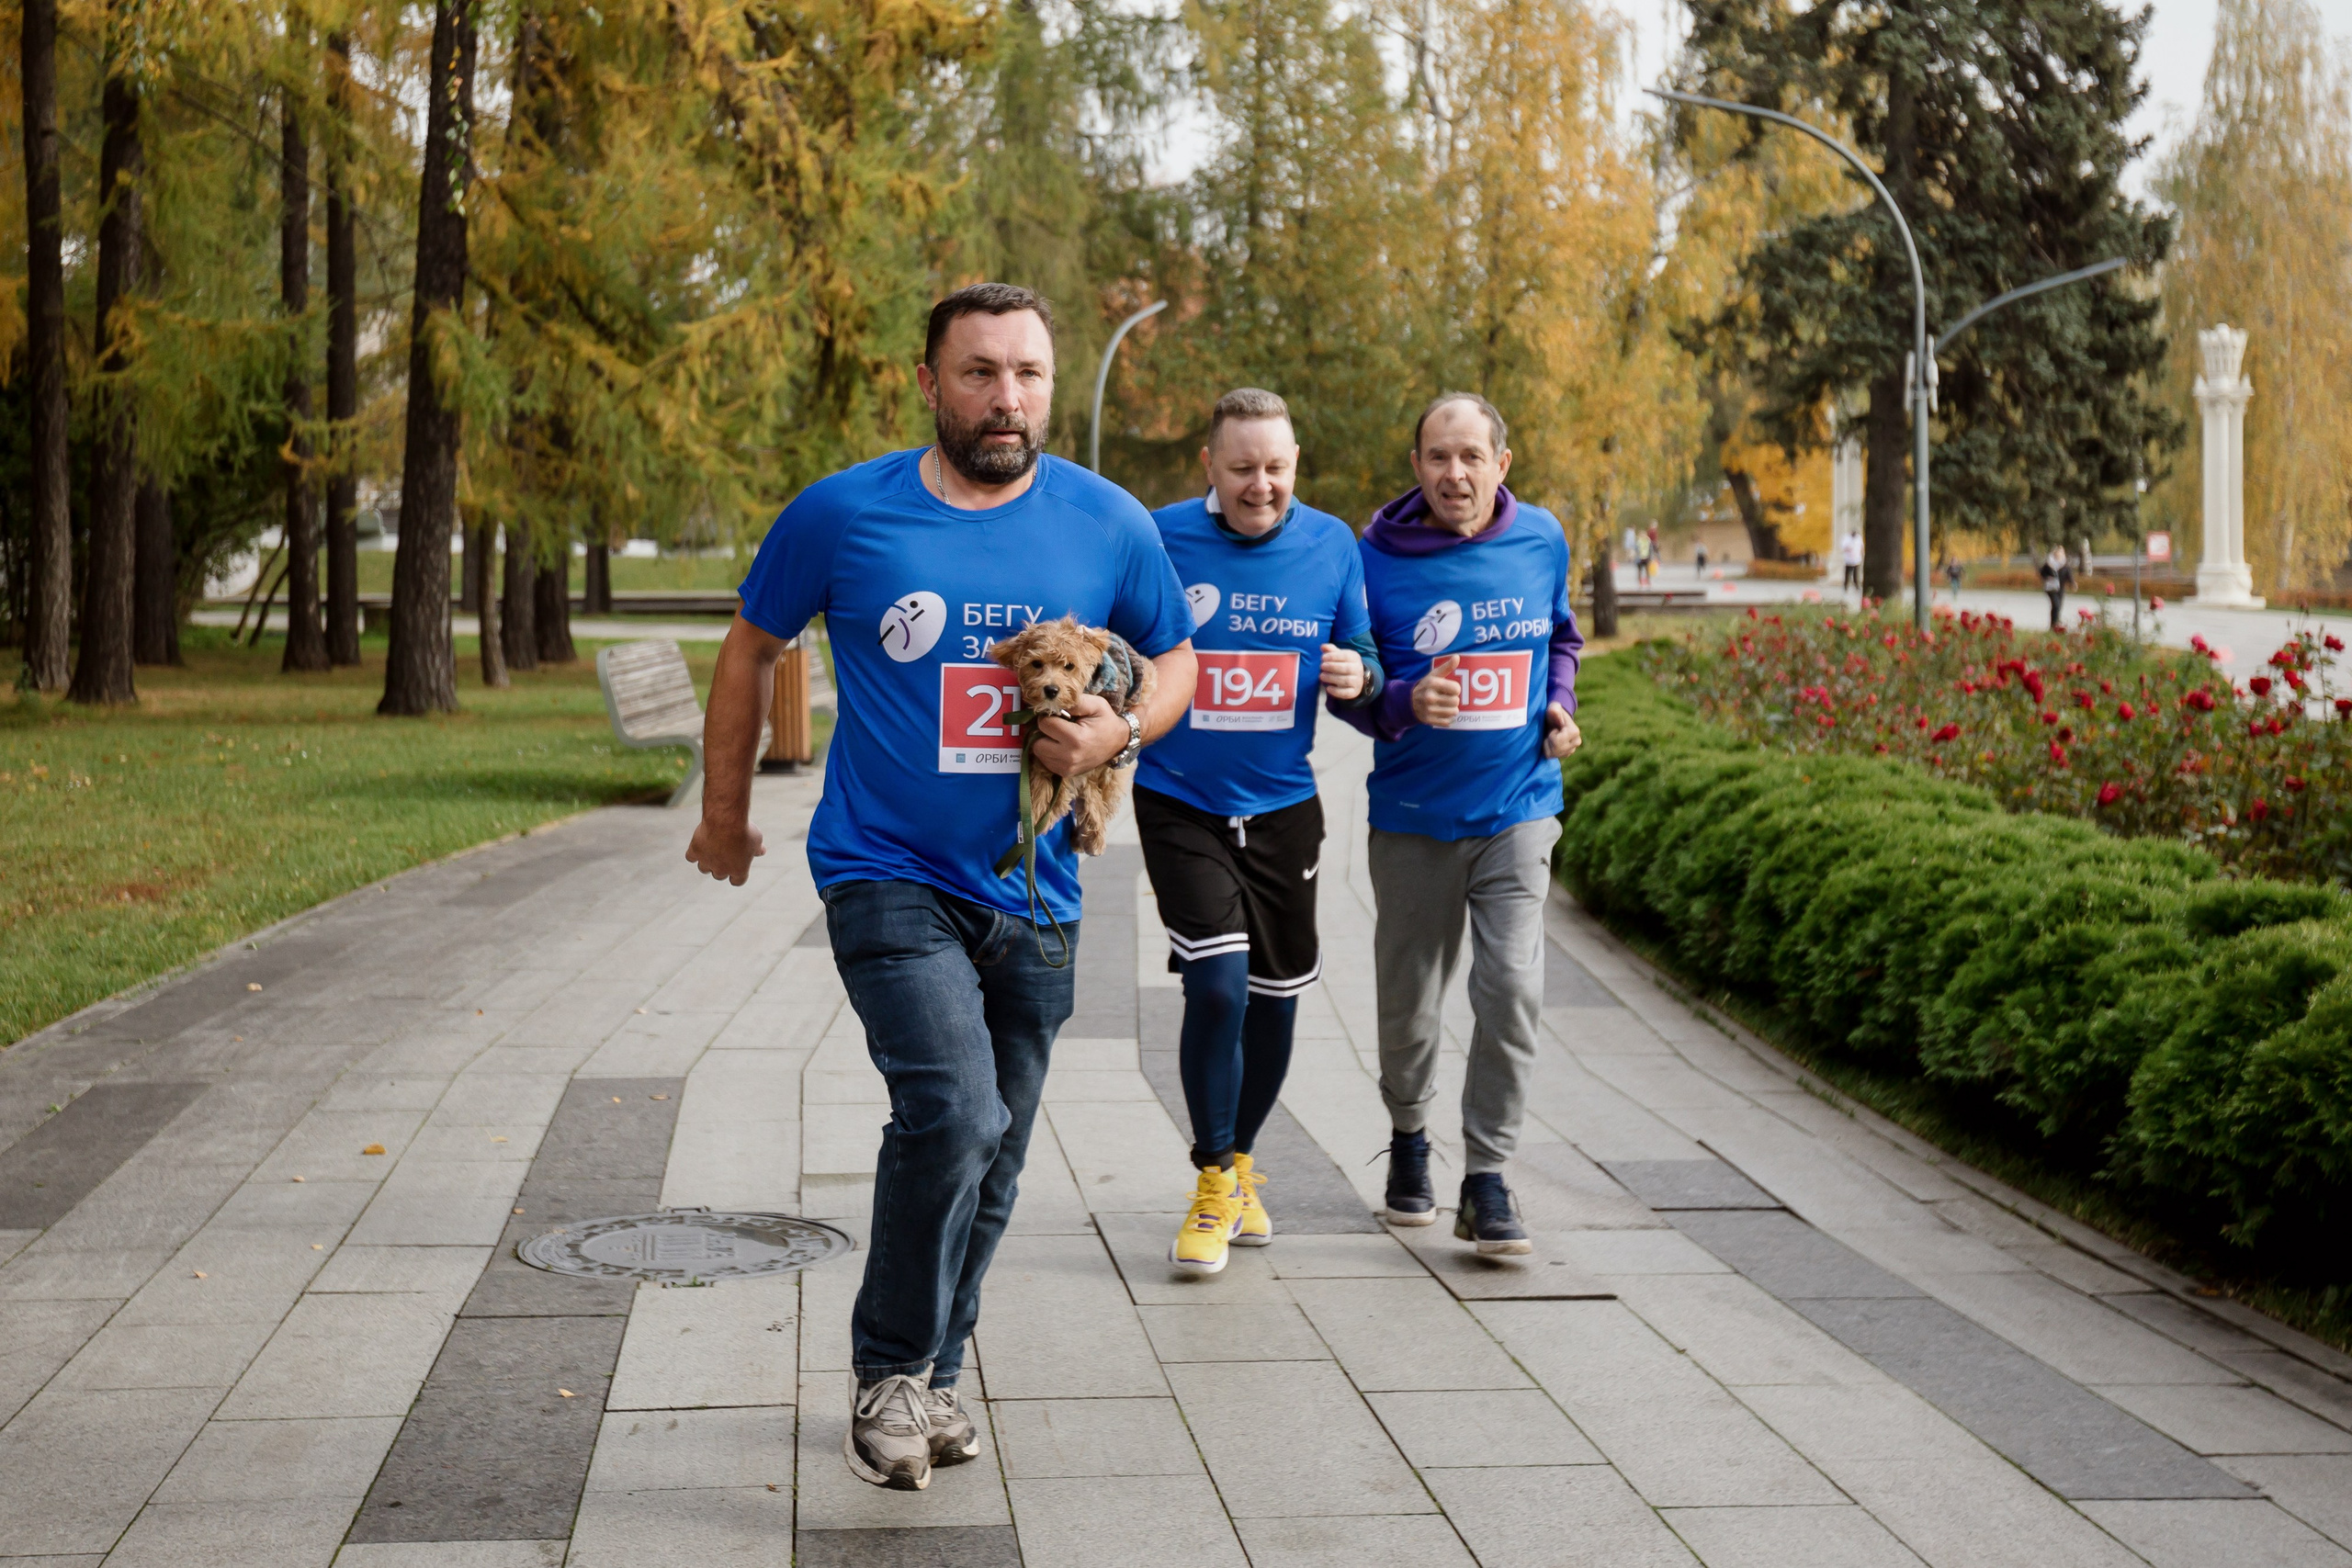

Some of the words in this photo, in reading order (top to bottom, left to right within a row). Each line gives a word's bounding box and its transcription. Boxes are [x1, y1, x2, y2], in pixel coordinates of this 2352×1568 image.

[1229, 592, 1287, 613] БЕГУ
[1472, 597, 1524, 621] БЕГУ
[963, 603, 1044, 627] БЕГУ
[1228, 615, 1257, 633] ЗА
[1261, 617, 1319, 637] ОРБИ
[1473, 624, 1502, 644] ЗА
[1505, 617, 1549, 640] ОРБИ
[1206, 667, 1285, 706] 194
[1454, 668, 1512, 705] 191
[975, 753, 1008, 763] ОРБИ
